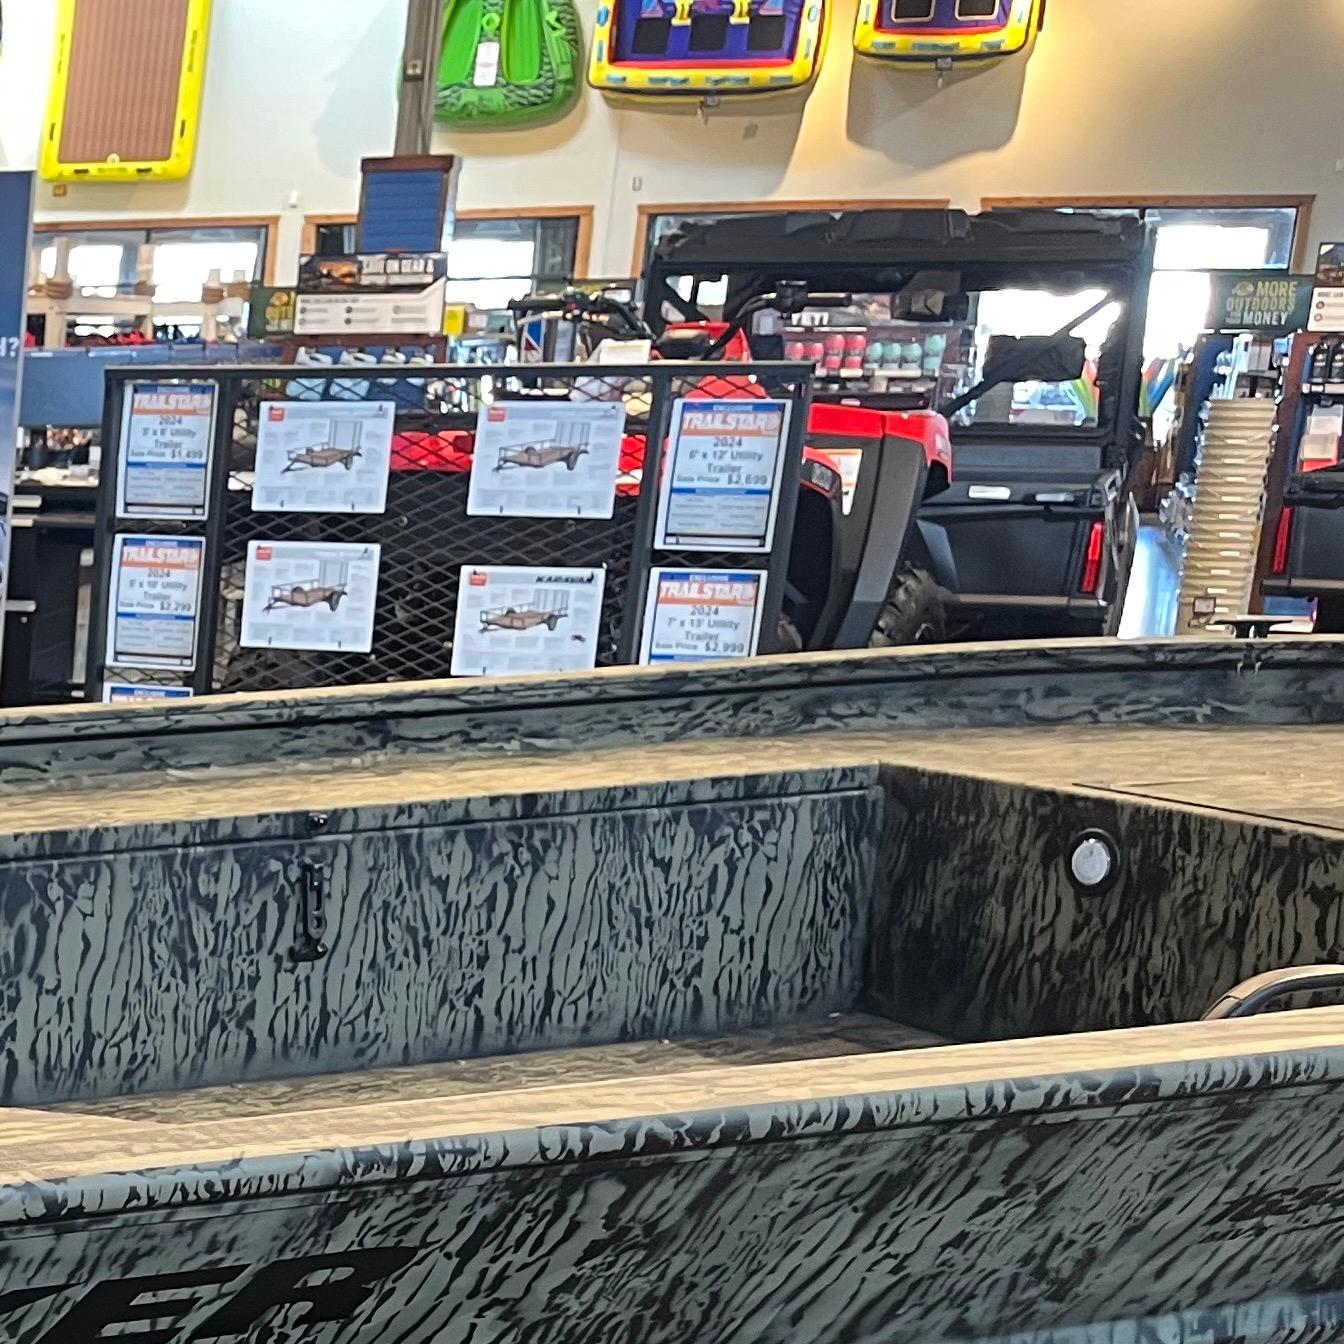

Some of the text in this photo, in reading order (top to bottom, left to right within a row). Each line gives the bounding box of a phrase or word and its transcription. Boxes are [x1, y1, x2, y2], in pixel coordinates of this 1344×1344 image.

[1255, 281, 1298, 297] MORE
[1225, 297, 1296, 314] OUTDOORS
[791, 311, 829, 327] YETI
[1242, 311, 1289, 326] MONEY
[683, 412, 767, 431] TRAILSTAR
[713, 438, 743, 448] 2024
[730, 450, 763, 462] Utility
[707, 463, 743, 474] Trailer
[660, 582, 744, 599] TRAILSTAR
[690, 606, 720, 616] 2024
